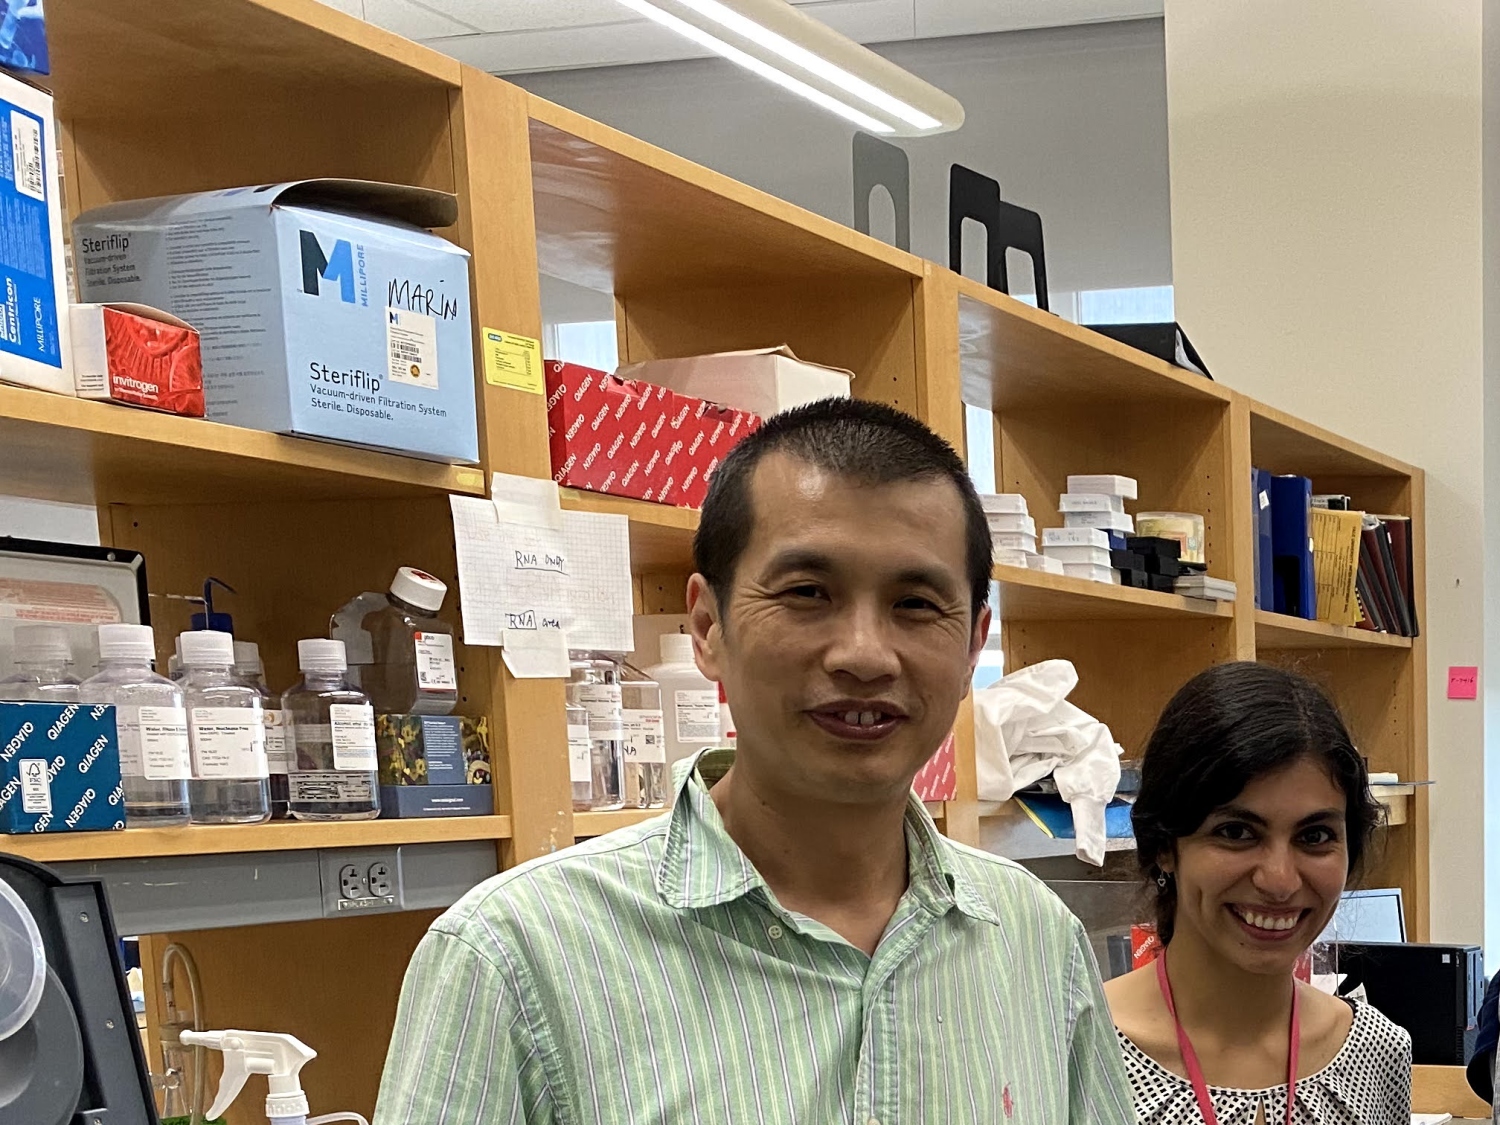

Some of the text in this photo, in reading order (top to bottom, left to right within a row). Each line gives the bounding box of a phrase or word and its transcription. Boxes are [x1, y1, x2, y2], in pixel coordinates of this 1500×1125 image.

[82, 234, 130, 255] Steriflip
[112, 263, 136, 274] System
[357, 243, 369, 308] MILLIPORE
[34, 296, 45, 353] MILLIPORE
[112, 372, 159, 394] invitrogen
[310, 362, 381, 394] Steriflip
[574, 374, 594, 402] QIAGEN
[310, 384, 447, 418] Vacuum-driven Filtration System
[614, 393, 632, 421] QIAGEN
[565, 413, 585, 442] QIAGEN
[591, 403, 610, 431] QIAGEN
[607, 432, 625, 459] QIAGEN
[629, 422, 647, 449] QIAGEN
[554, 453, 577, 482] QIAGEN
[583, 443, 601, 470] QIAGEN
[621, 460, 640, 487] QIAGEN
[515, 550, 537, 567] RNA
[509, 614, 533, 629] RNA
[47, 704, 80, 740] QIAGEN
[0, 721, 34, 762] QIAGEN
[78, 734, 109, 774] QIAGEN
[65, 788, 96, 828] QIAGEN
[1133, 935, 1155, 959] QIAGEN
